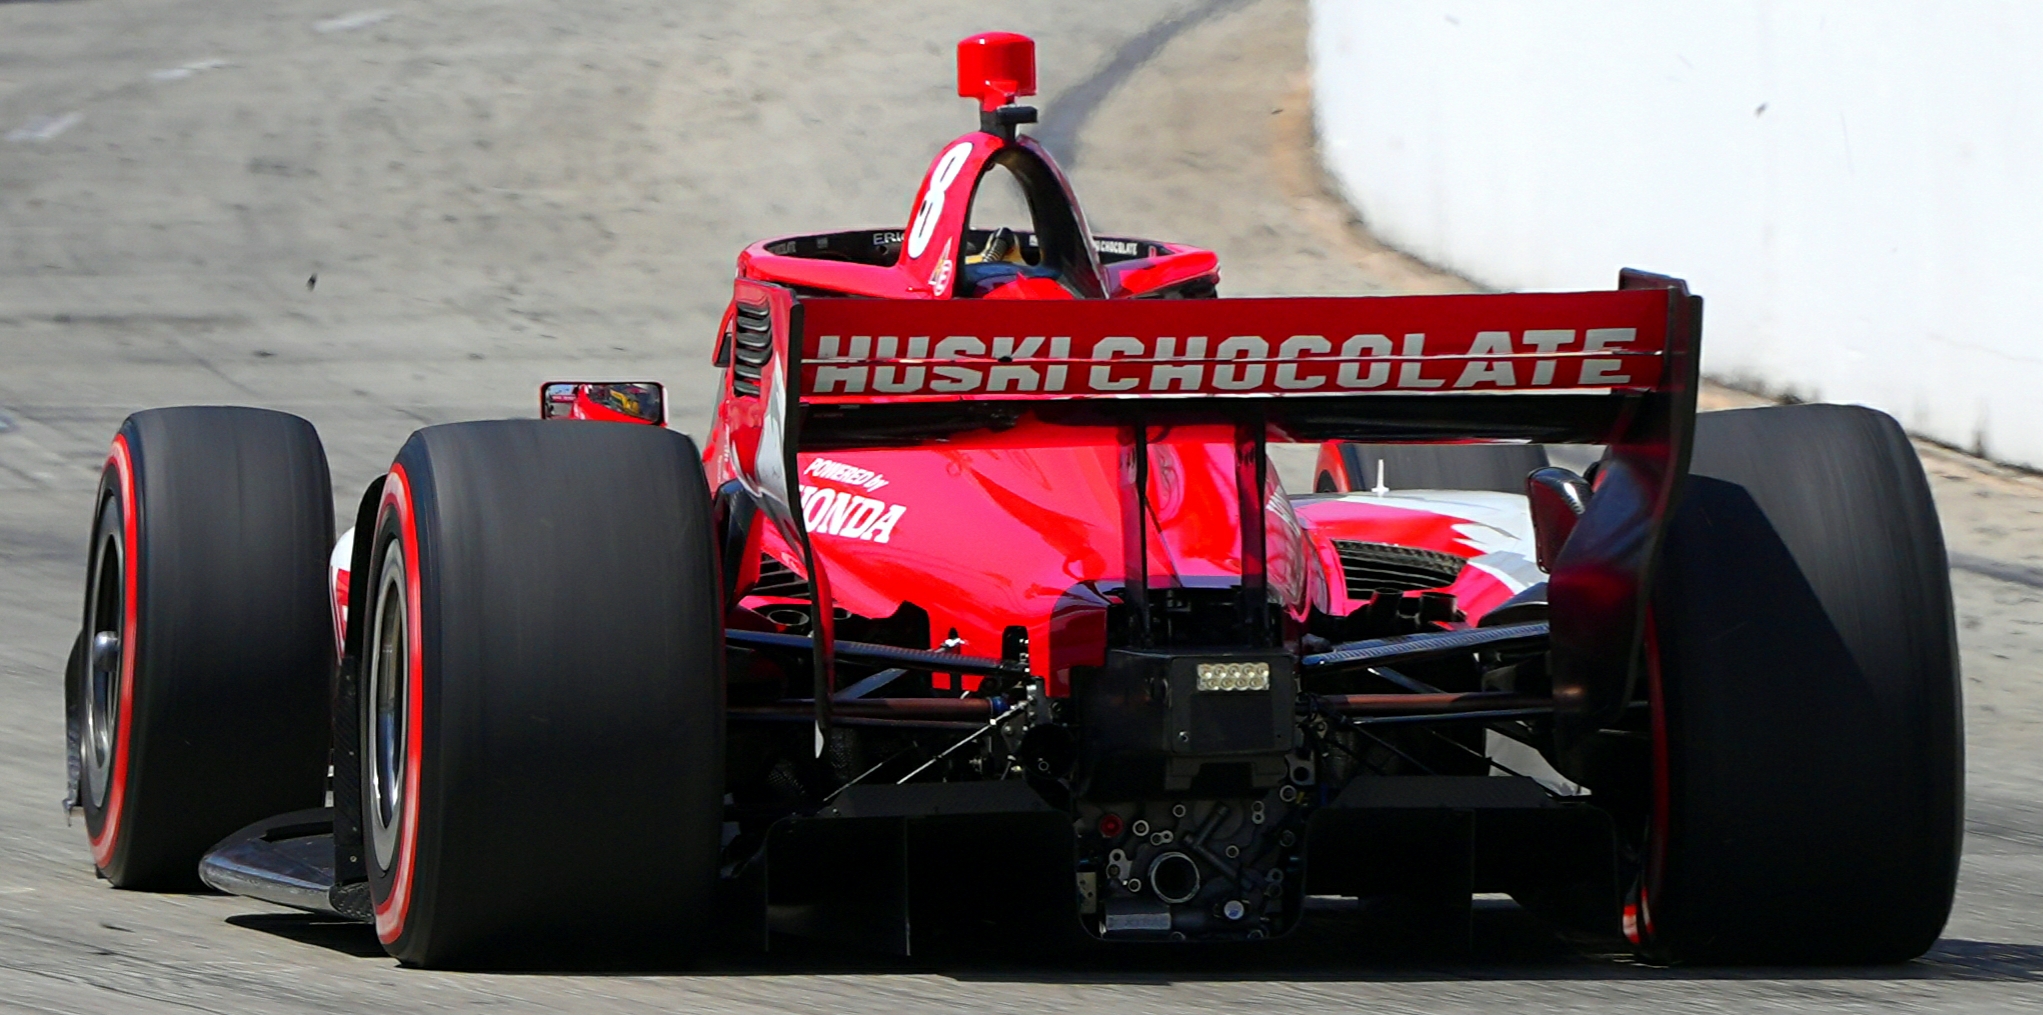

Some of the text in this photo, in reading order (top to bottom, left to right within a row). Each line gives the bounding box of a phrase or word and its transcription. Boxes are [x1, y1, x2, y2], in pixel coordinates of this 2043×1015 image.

[907, 141, 974, 259] 8
[813, 327, 1637, 393] HUSKI CHOCOLATE
[803, 457, 875, 486] POWERED
